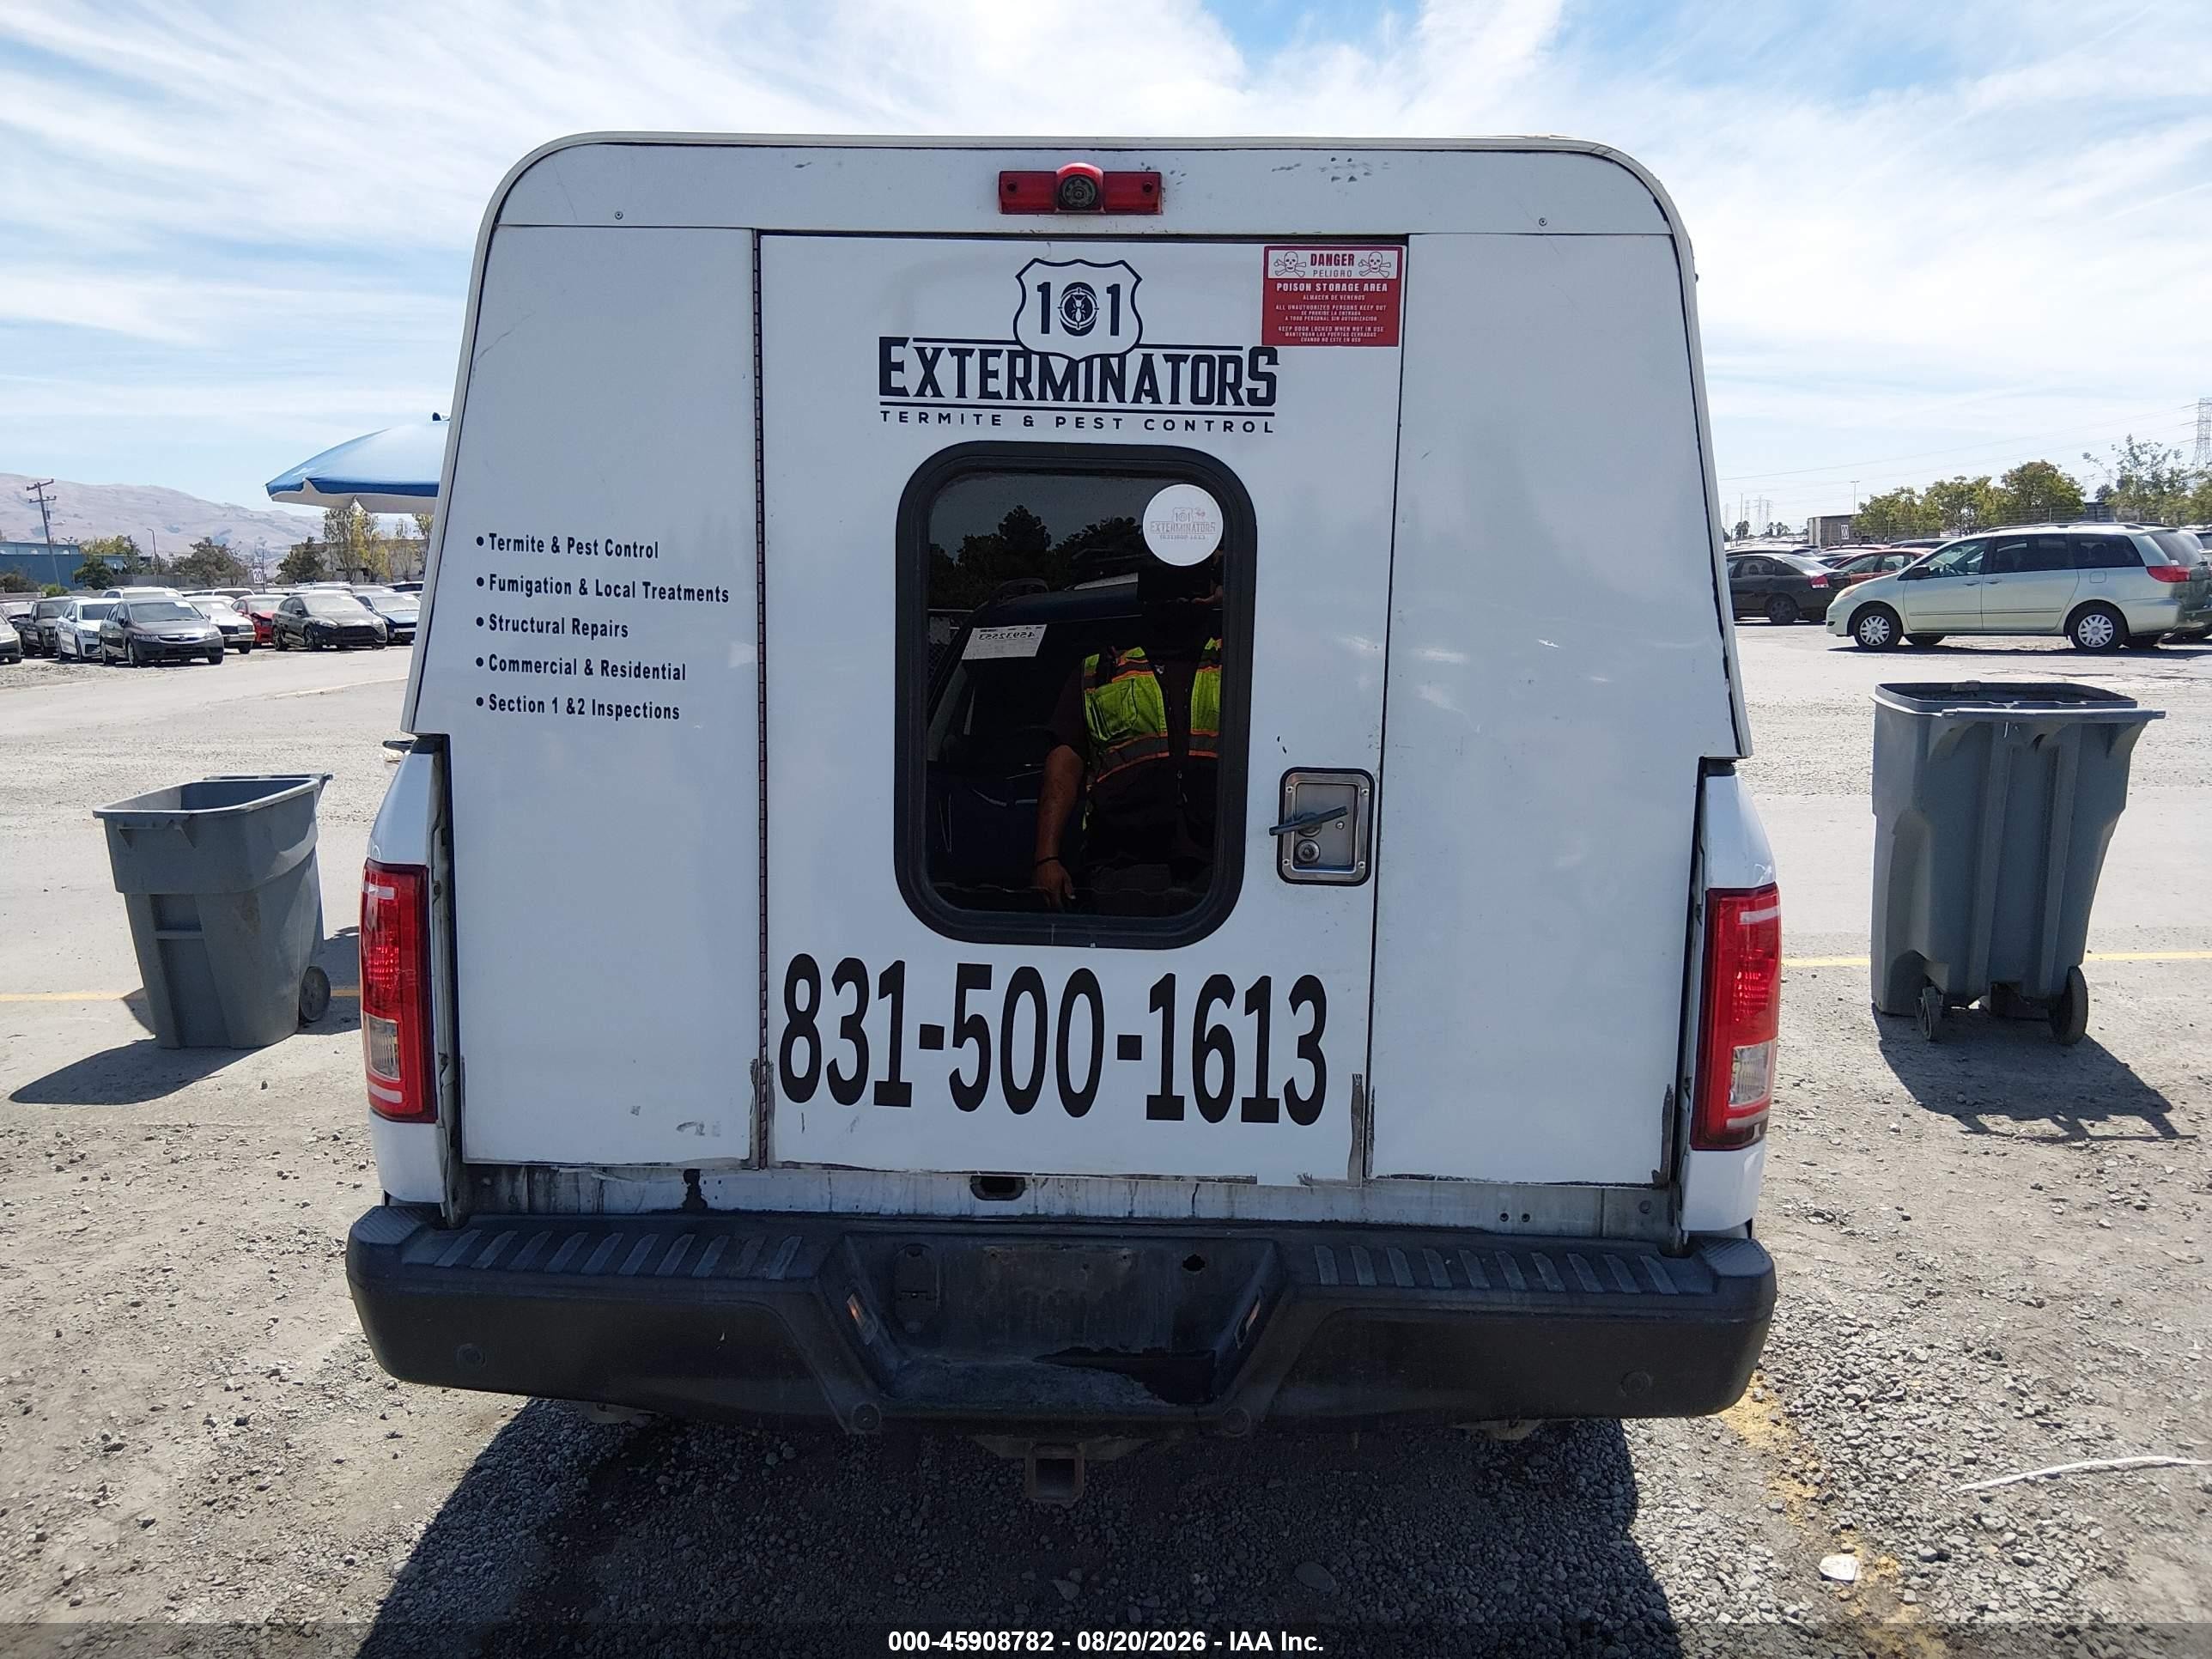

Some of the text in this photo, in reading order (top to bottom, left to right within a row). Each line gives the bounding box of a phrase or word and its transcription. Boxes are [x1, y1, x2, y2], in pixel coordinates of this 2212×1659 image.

[1310, 253, 1355, 266] DANGER
[1277, 283, 1388, 292] POISON STORAGE AREA
[1037, 282, 1121, 337] 101
[879, 337, 1280, 407] EXTERMINATORS
[880, 410, 1274, 434] TERMITE & PEST CONTROL
[489, 532, 659, 558] Termite & Pest Control
[254, 570, 263, 582] 20
[489, 574, 729, 603] Fumigation & Local Treatments
[489, 613, 629, 641] Structural Repairs
[489, 653, 686, 681] Commercial & Residential
[489, 694, 545, 714] Section
[551, 697, 559, 715] 1
[592, 699, 680, 721] Inspections
[779, 953, 1328, 1126] 831-500-1613
